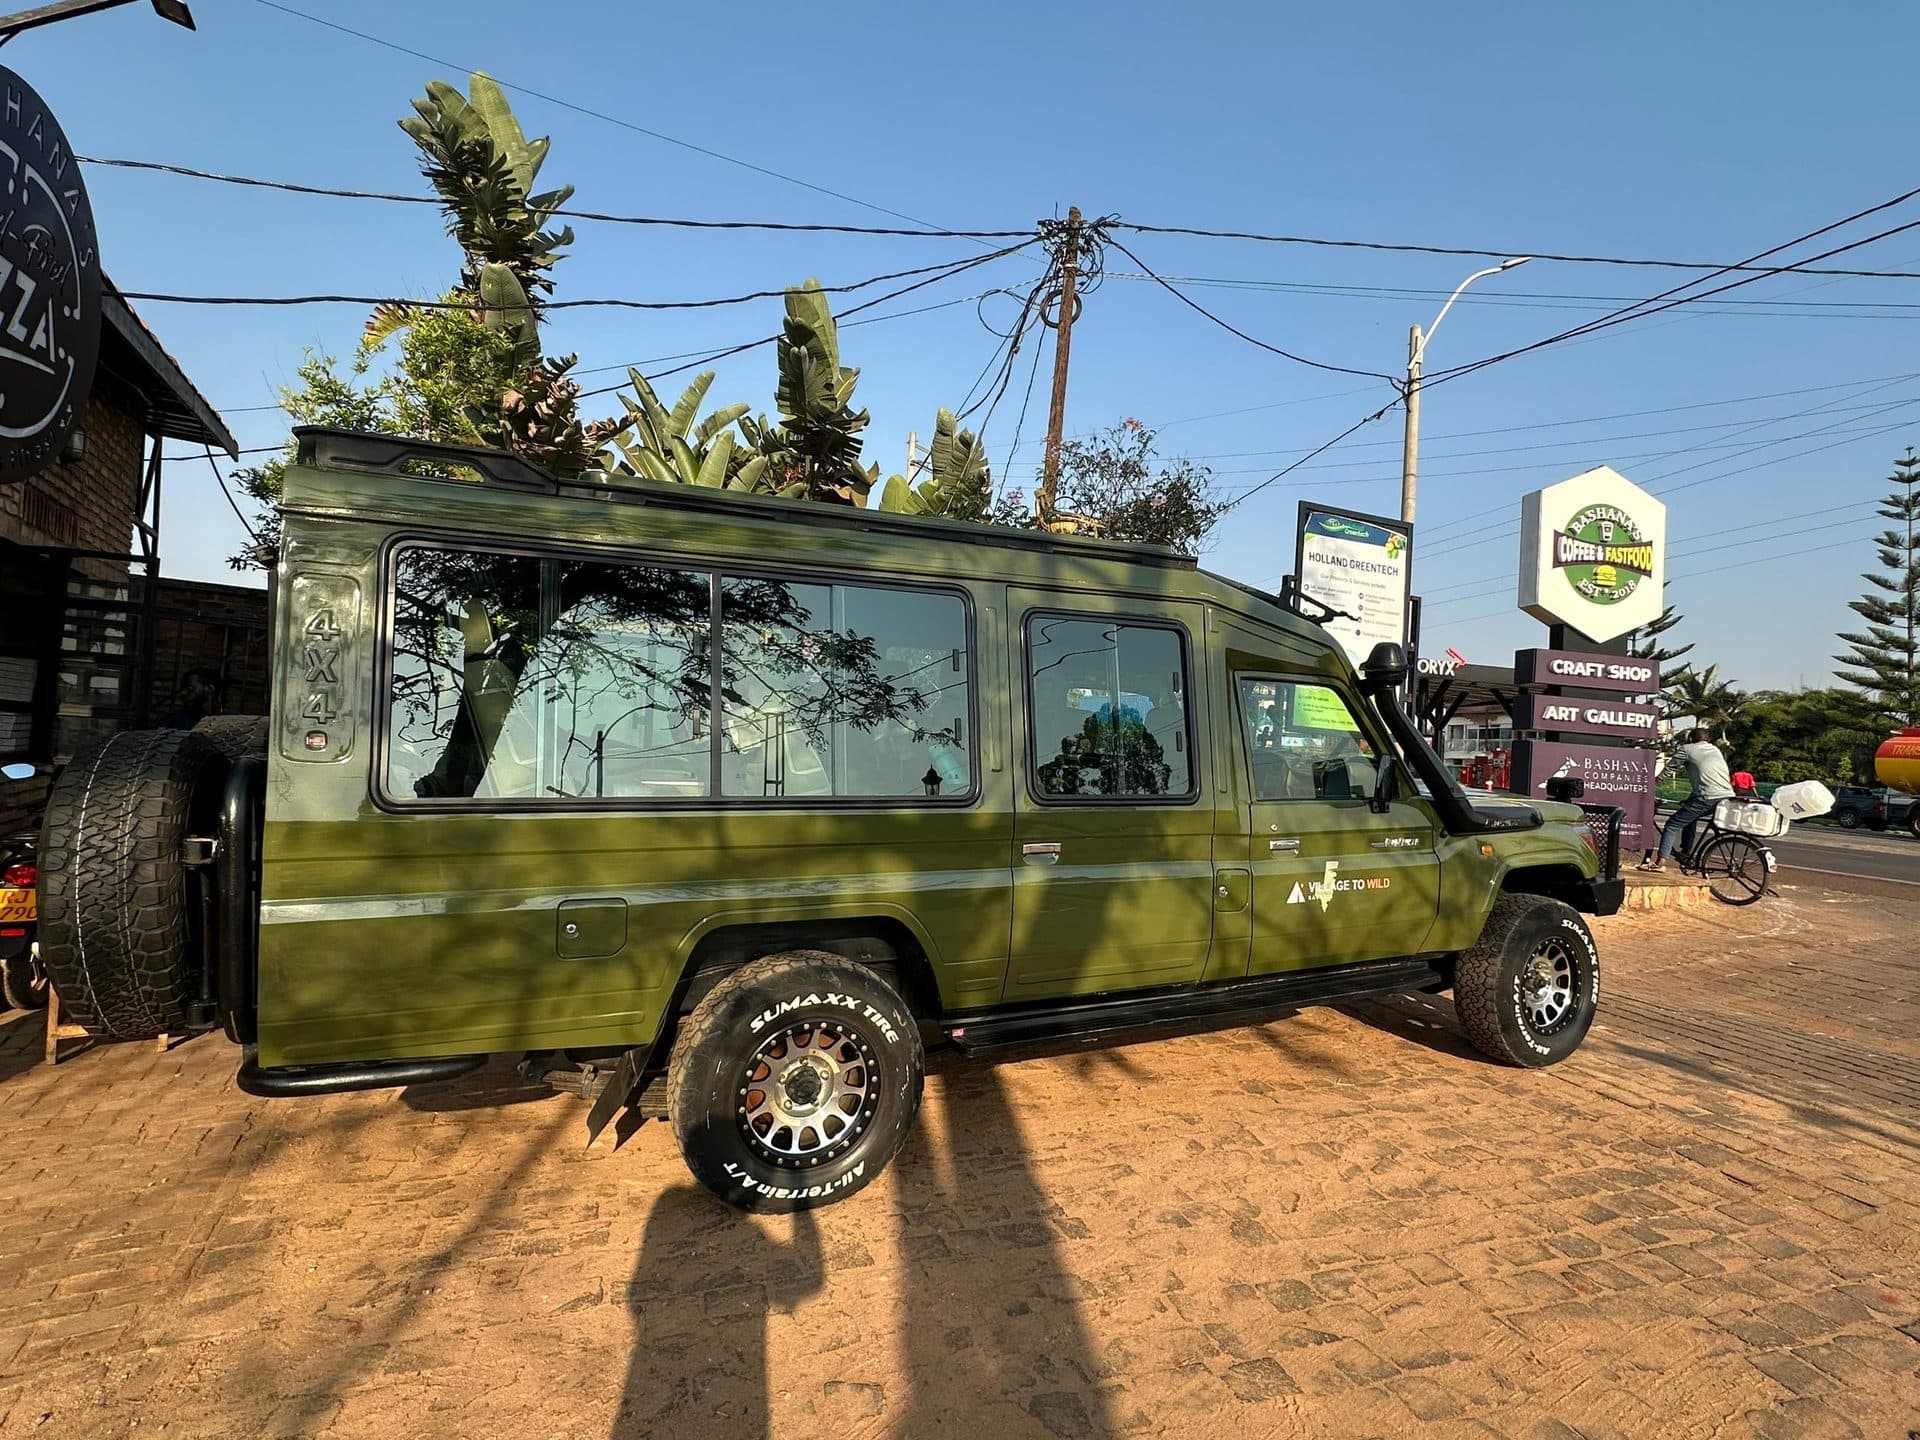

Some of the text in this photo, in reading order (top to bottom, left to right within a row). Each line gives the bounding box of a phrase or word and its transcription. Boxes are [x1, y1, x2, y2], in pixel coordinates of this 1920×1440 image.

[1571, 507, 1643, 541] BASHANA'S
[1309, 552, 1398, 577] HOLLAND GREENTECH
[1559, 536, 1653, 571] COFFEE & FASTFOOD
[1611, 580, 1636, 599] 2018
[1416, 659, 1456, 676] ORYX
[1552, 659, 1652, 682] CRAFT SHOP
[1543, 705, 1655, 728] ART GALLERY
[1584, 758, 1648, 773] BASHANA
[1584, 771, 1648, 783] COMPANIES
[1584, 782, 1648, 793] HEADQUARTERS
[1352, 879, 1365, 890] TO
[1366, 878, 1390, 889] WILD
[1561, 919, 1599, 1005] SUMAXX TIRE
[749, 993, 900, 1045] SUMAXX TIRE
[756, 1160, 866, 1200] All-Terrain
